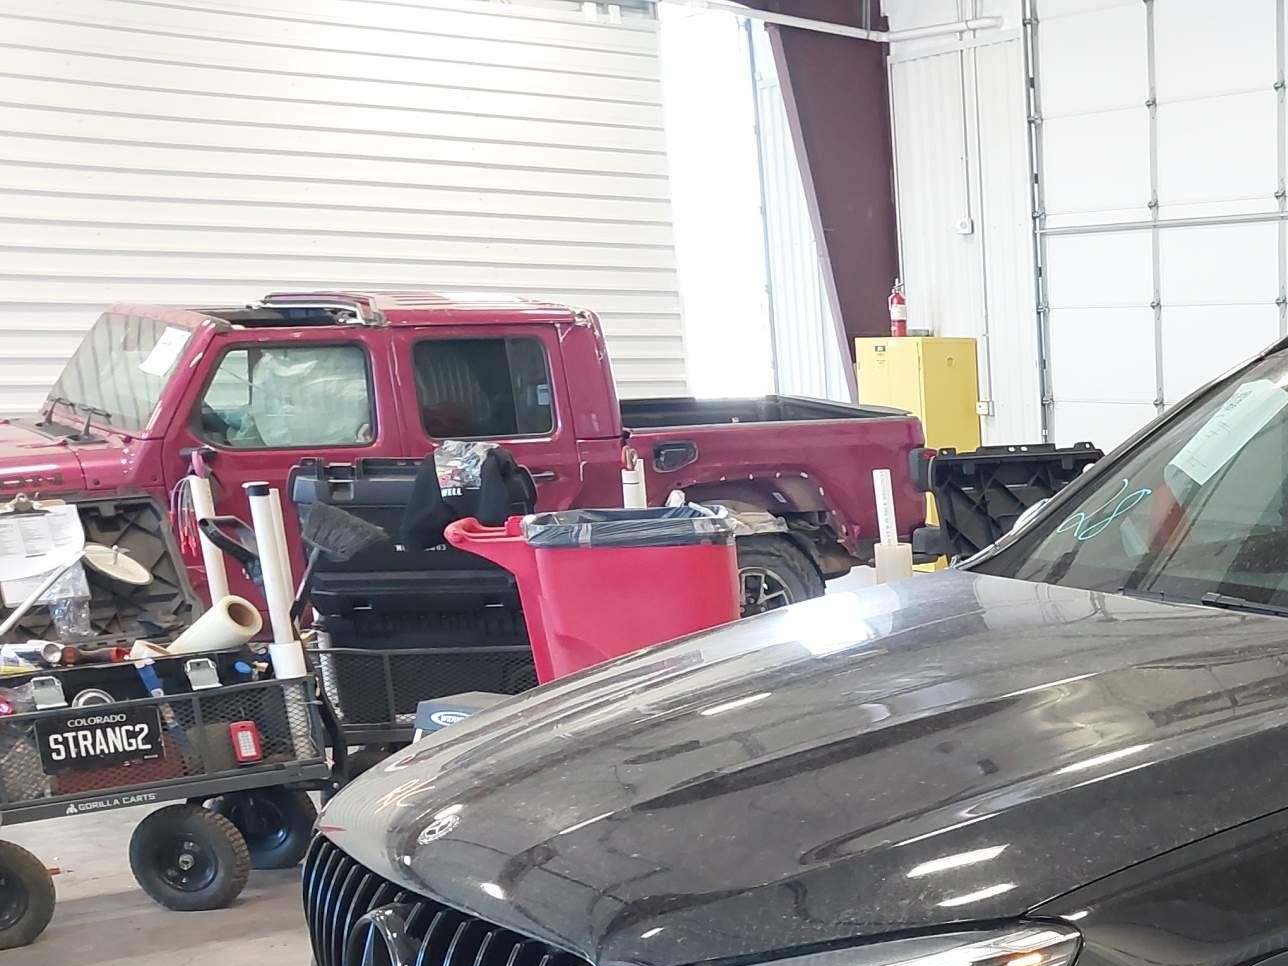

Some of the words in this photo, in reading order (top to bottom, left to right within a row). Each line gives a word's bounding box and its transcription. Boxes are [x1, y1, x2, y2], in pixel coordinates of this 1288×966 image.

[67, 714, 127, 728] COLORADO
[49, 723, 152, 760] STRANG2
[77, 799, 120, 812] GORILLA
[122, 793, 157, 805] CARTS
